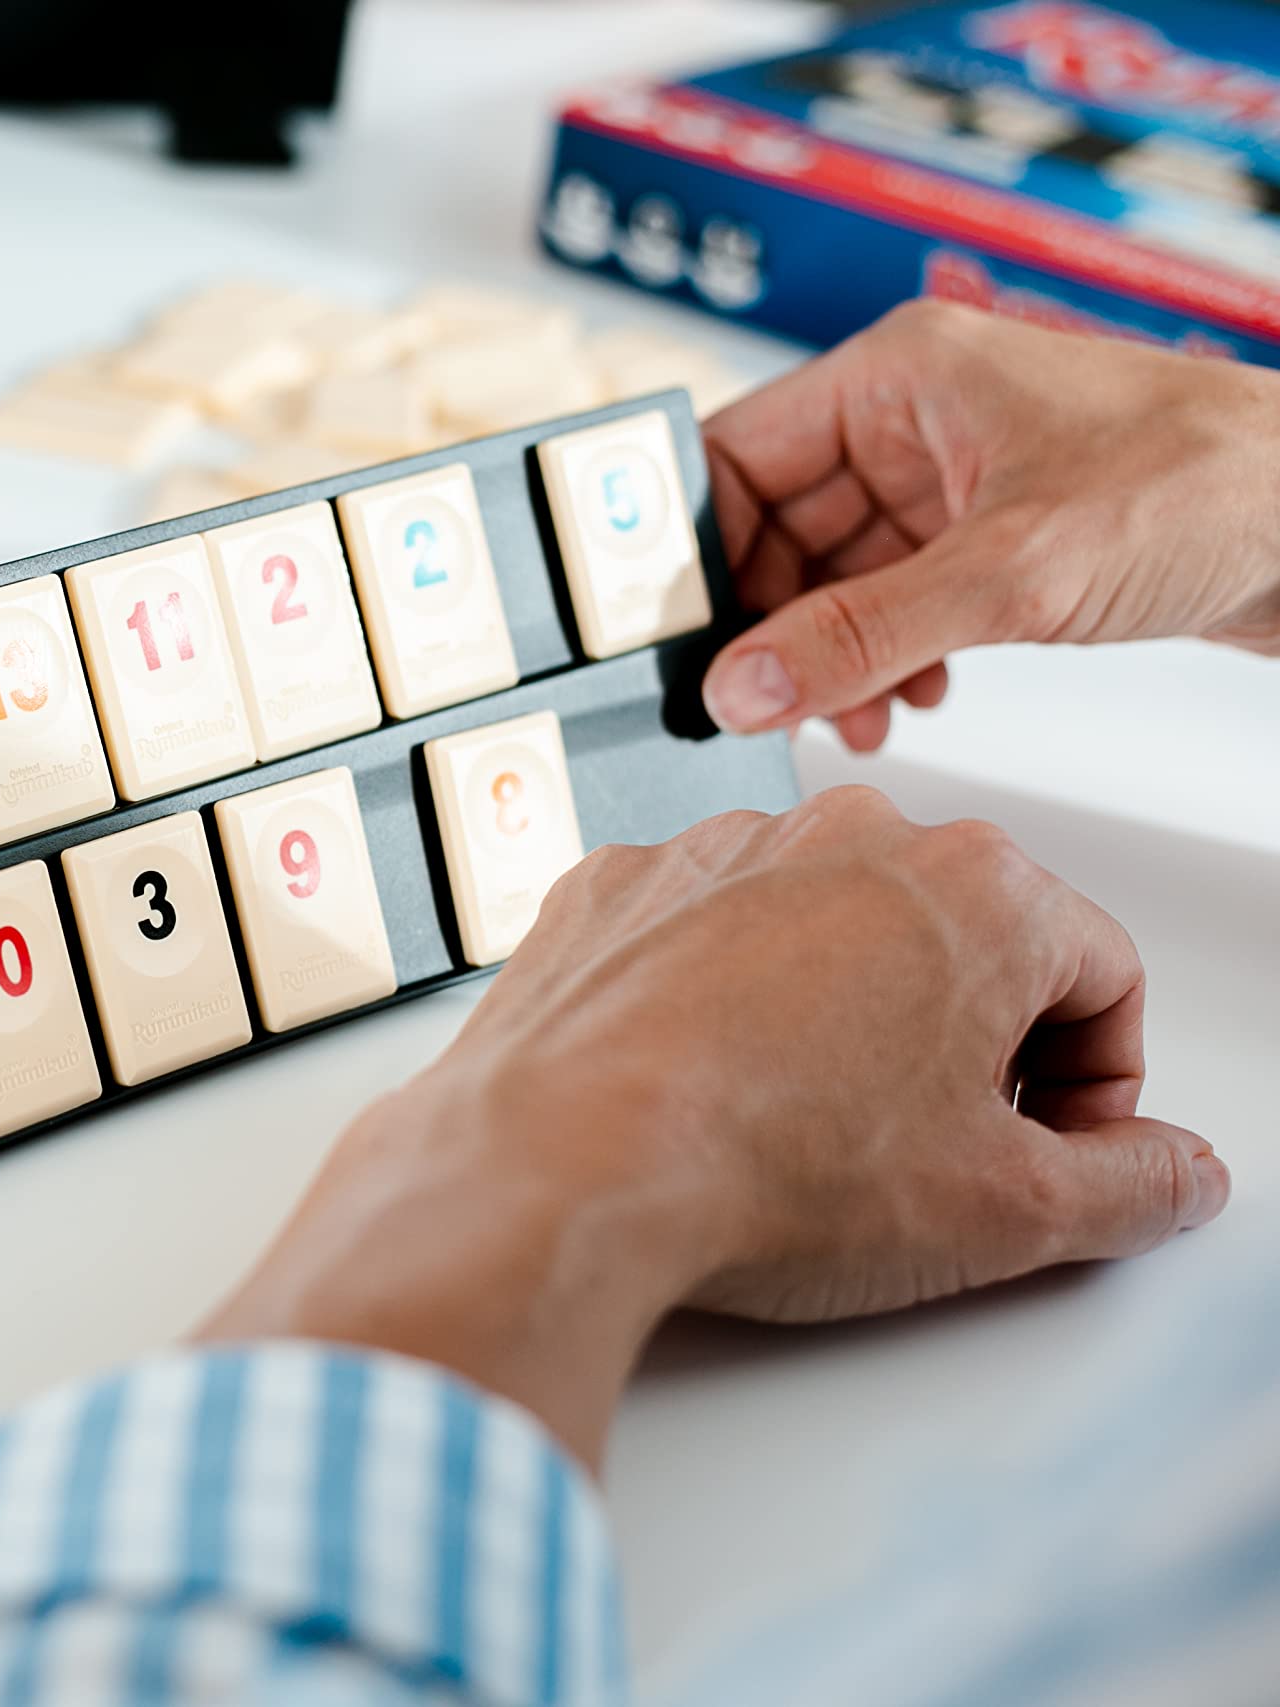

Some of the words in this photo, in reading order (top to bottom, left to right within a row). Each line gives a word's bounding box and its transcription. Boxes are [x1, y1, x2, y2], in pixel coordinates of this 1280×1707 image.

[602, 466, 641, 533] 5
[261, 553, 309, 626] 2
[403, 519, 449, 590] 2
[126, 591, 195, 672] 11
[491, 771, 530, 837] 8
[278, 829, 321, 900] 9
[132, 870, 178, 941] 3
[130, 992, 233, 1047] Rummikub
